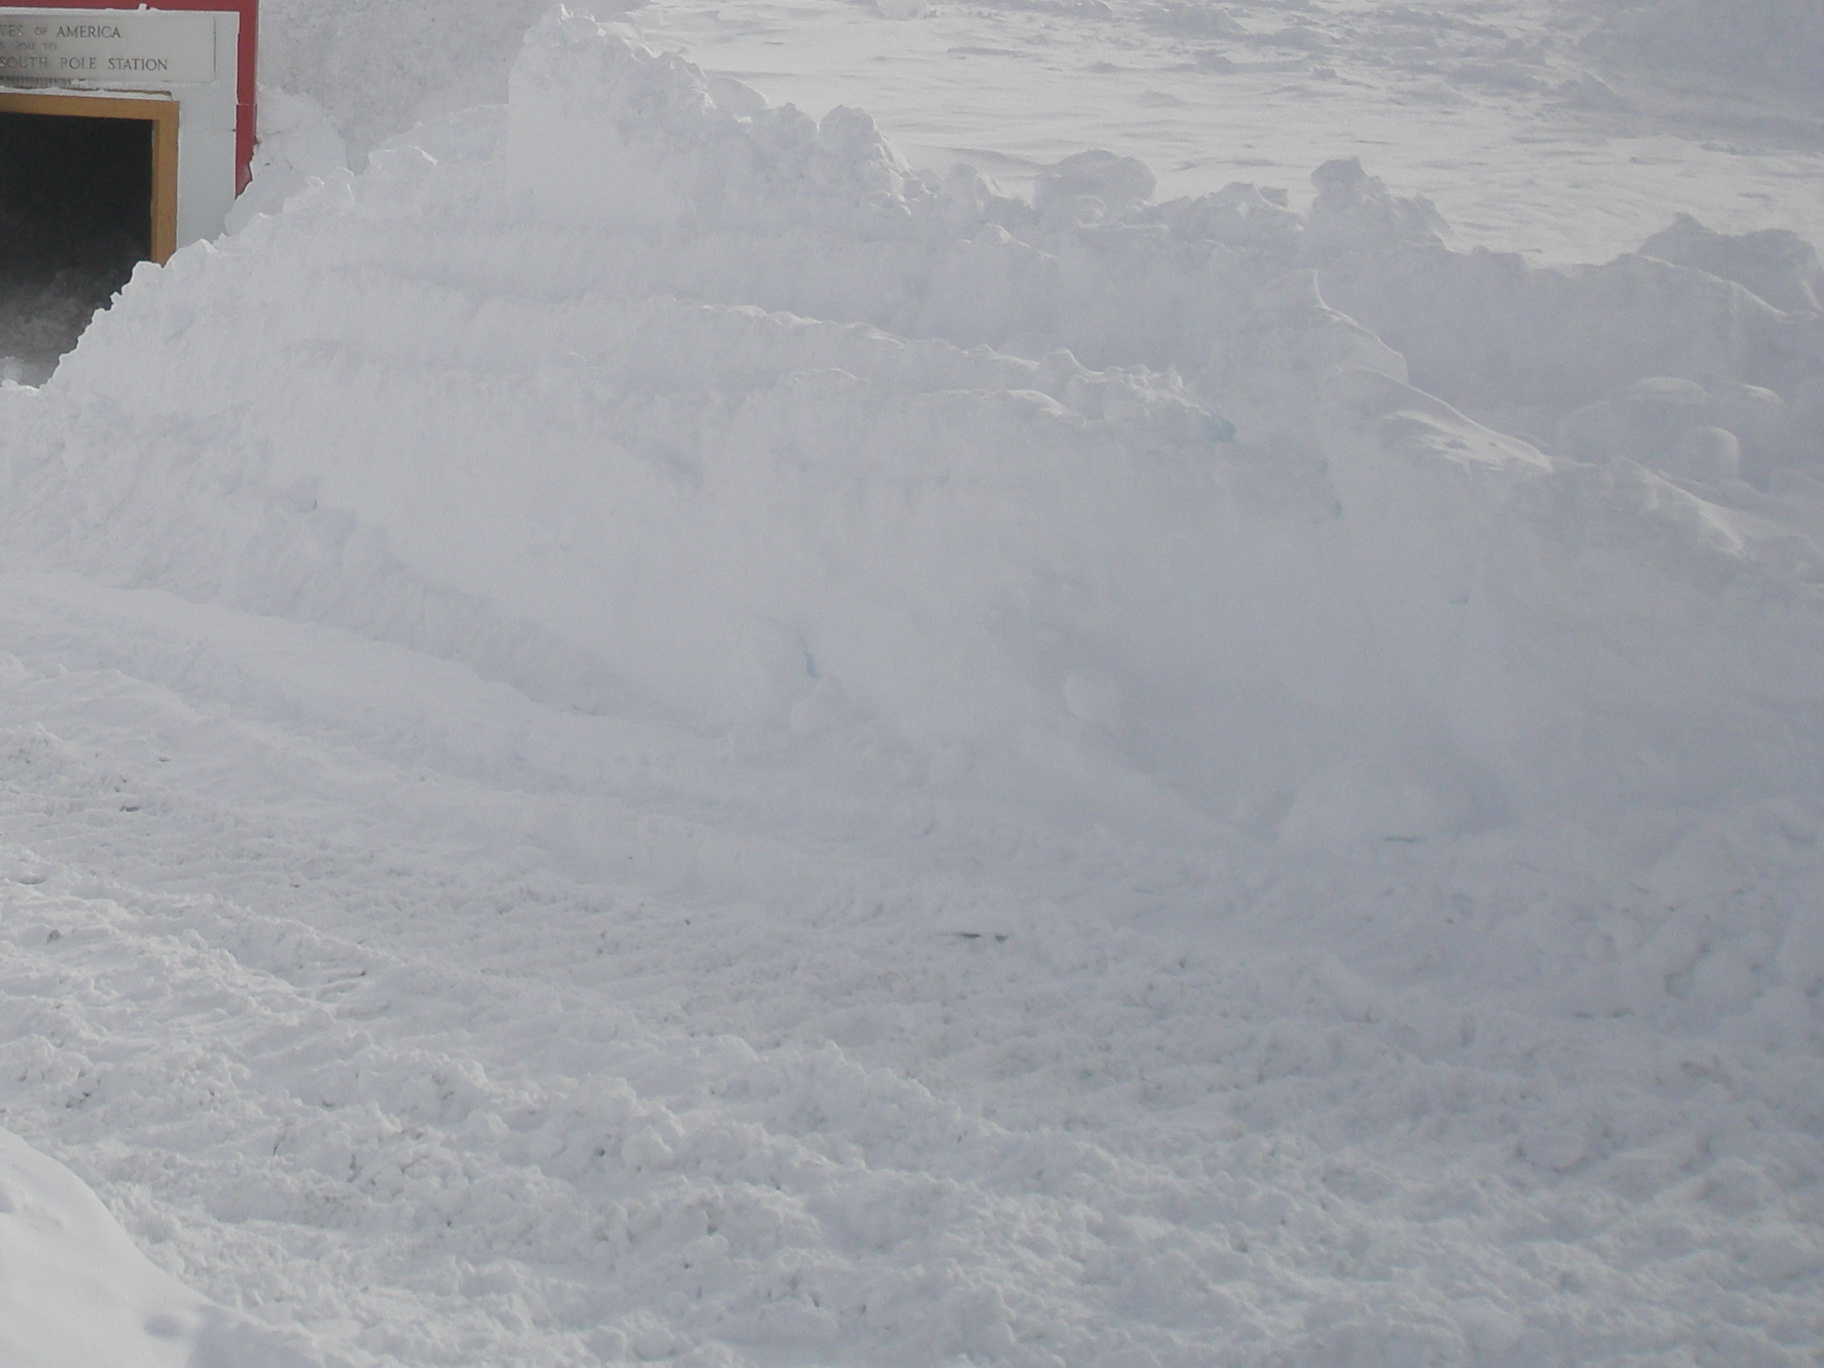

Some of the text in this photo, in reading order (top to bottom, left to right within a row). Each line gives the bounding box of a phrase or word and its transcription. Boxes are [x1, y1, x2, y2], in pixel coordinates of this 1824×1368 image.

[34, 25, 48, 36] OF
[56, 25, 121, 38] AMERICA
[43, 43, 58, 52] TO
[0, 56, 48, 69] SOUTH
[60, 57, 97, 70] POLE
[107, 57, 168, 71] STATION
